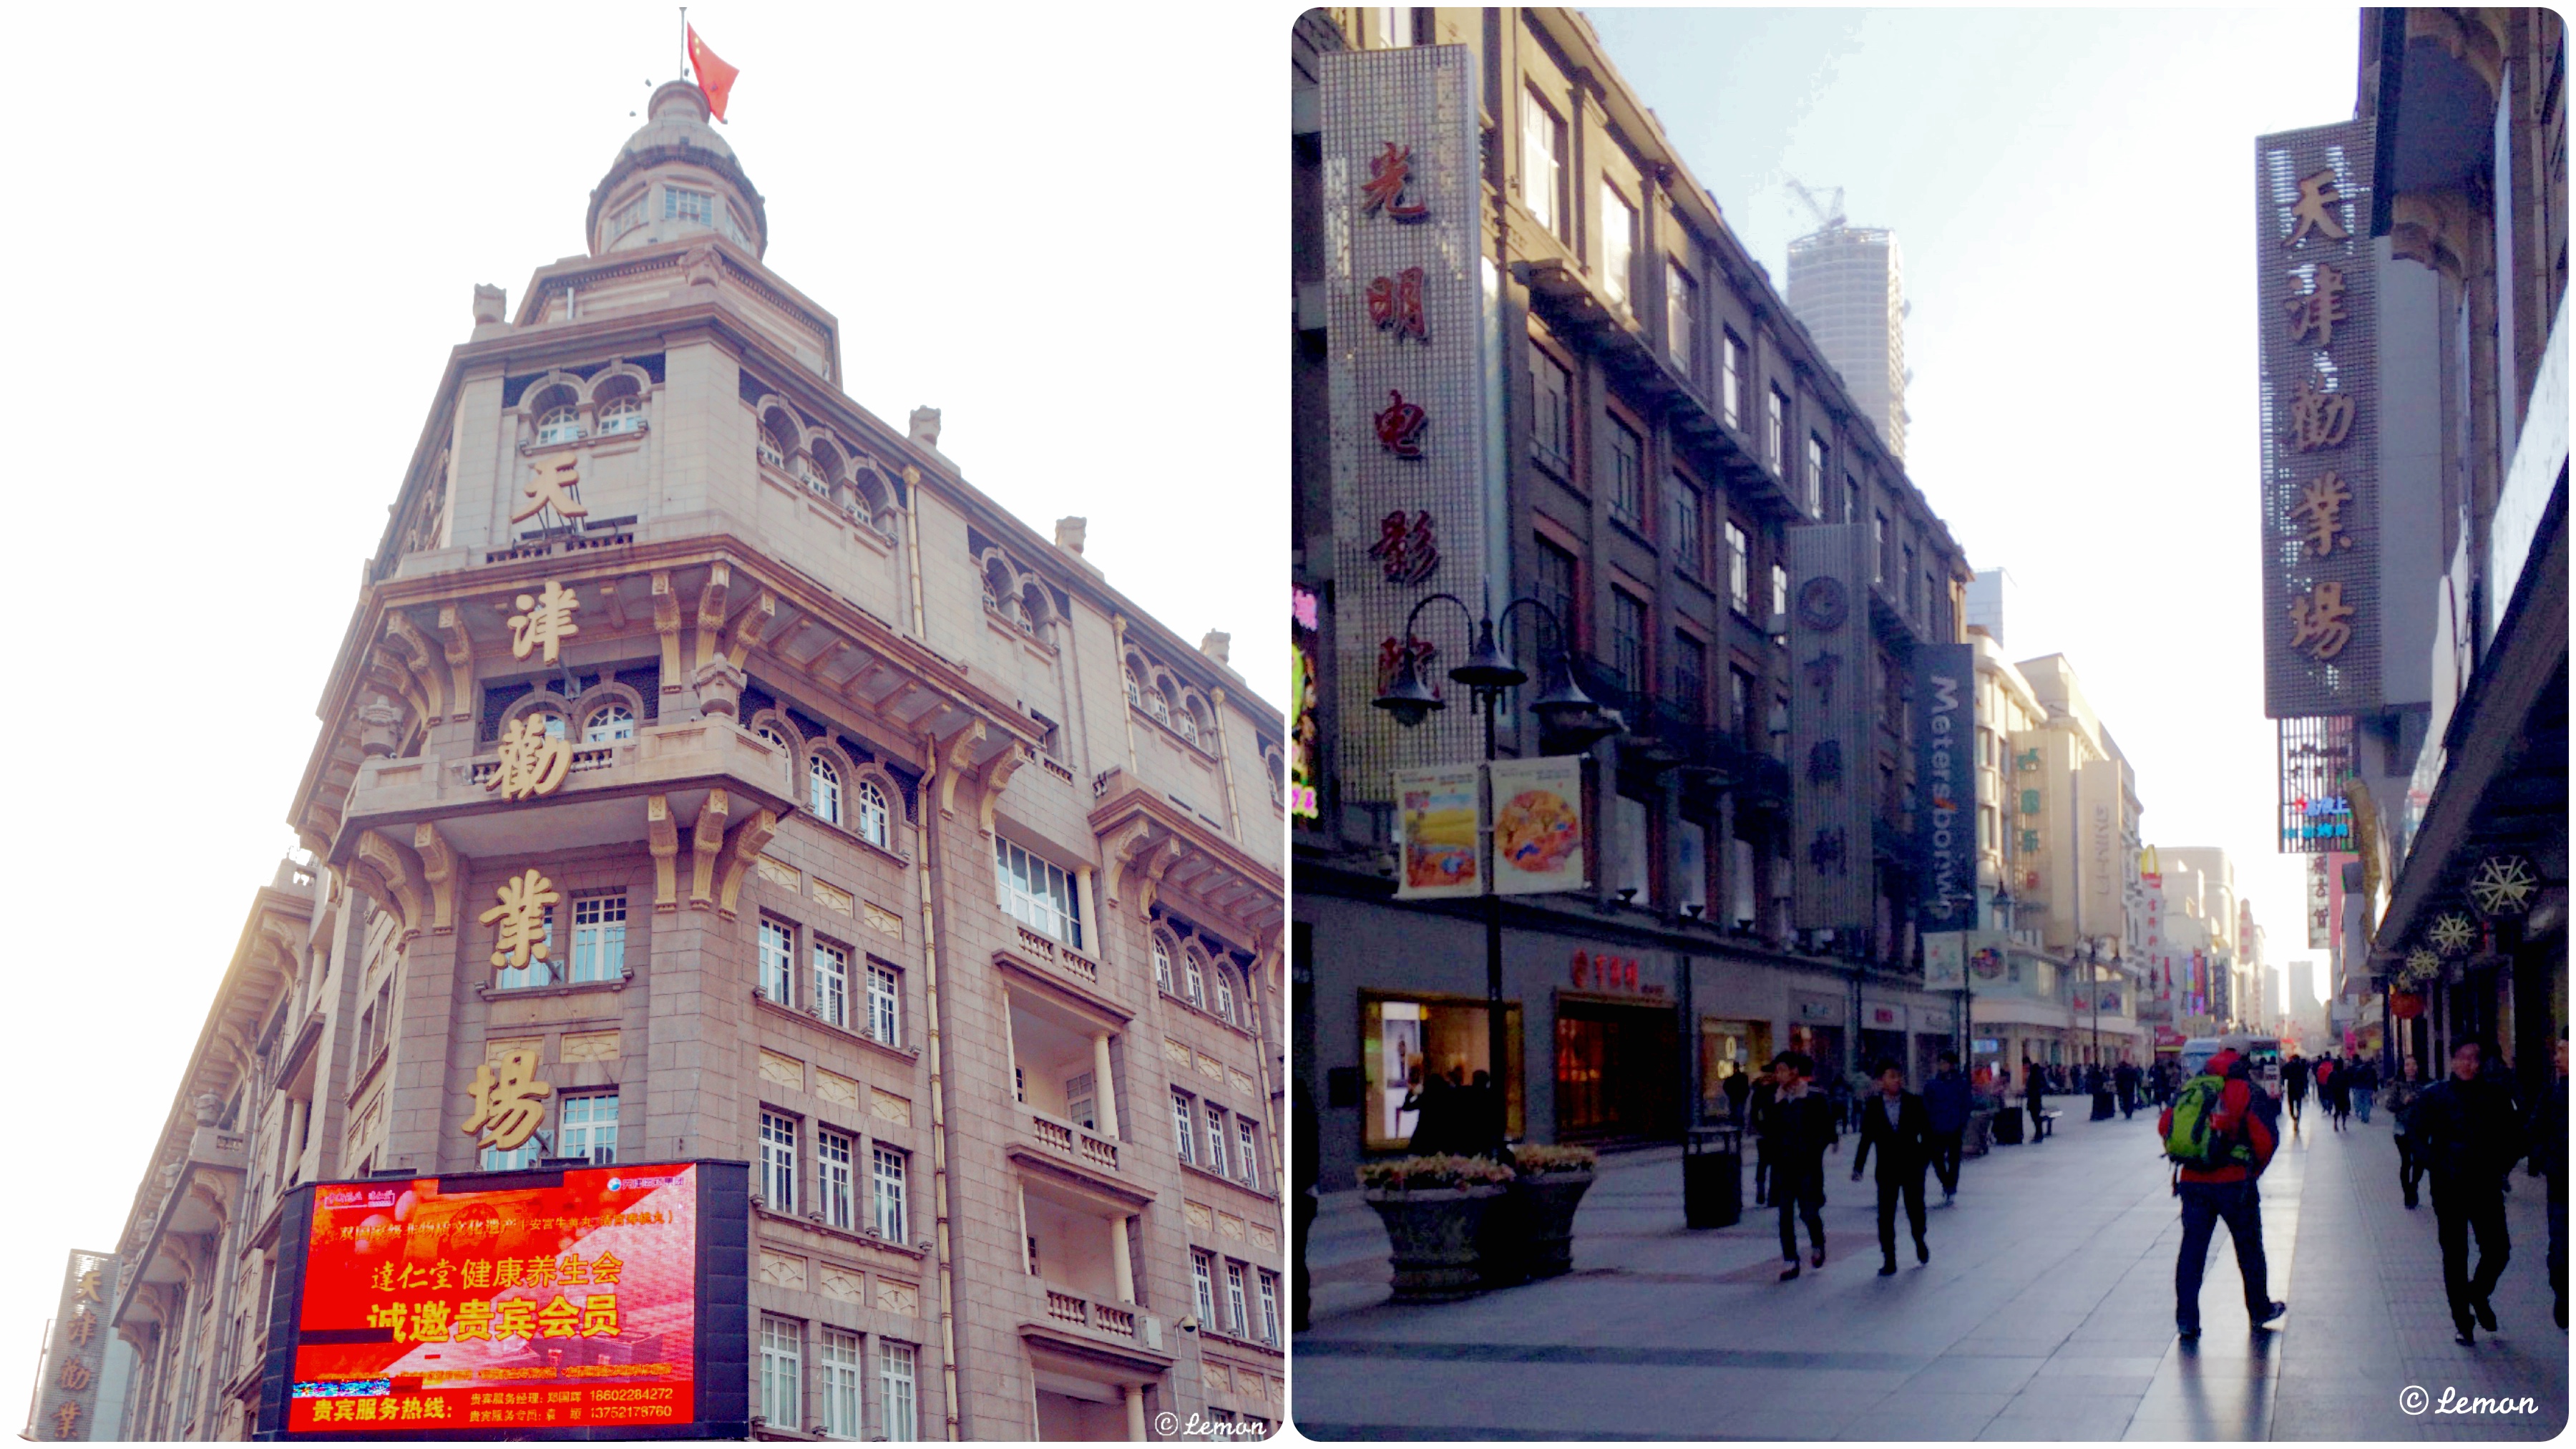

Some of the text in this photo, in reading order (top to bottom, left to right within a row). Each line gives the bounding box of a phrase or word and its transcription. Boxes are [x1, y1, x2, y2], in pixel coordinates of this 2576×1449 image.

[366, 1293, 621, 1343] 诚邀贵宾会员
[589, 1387, 673, 1402] 18602284272
